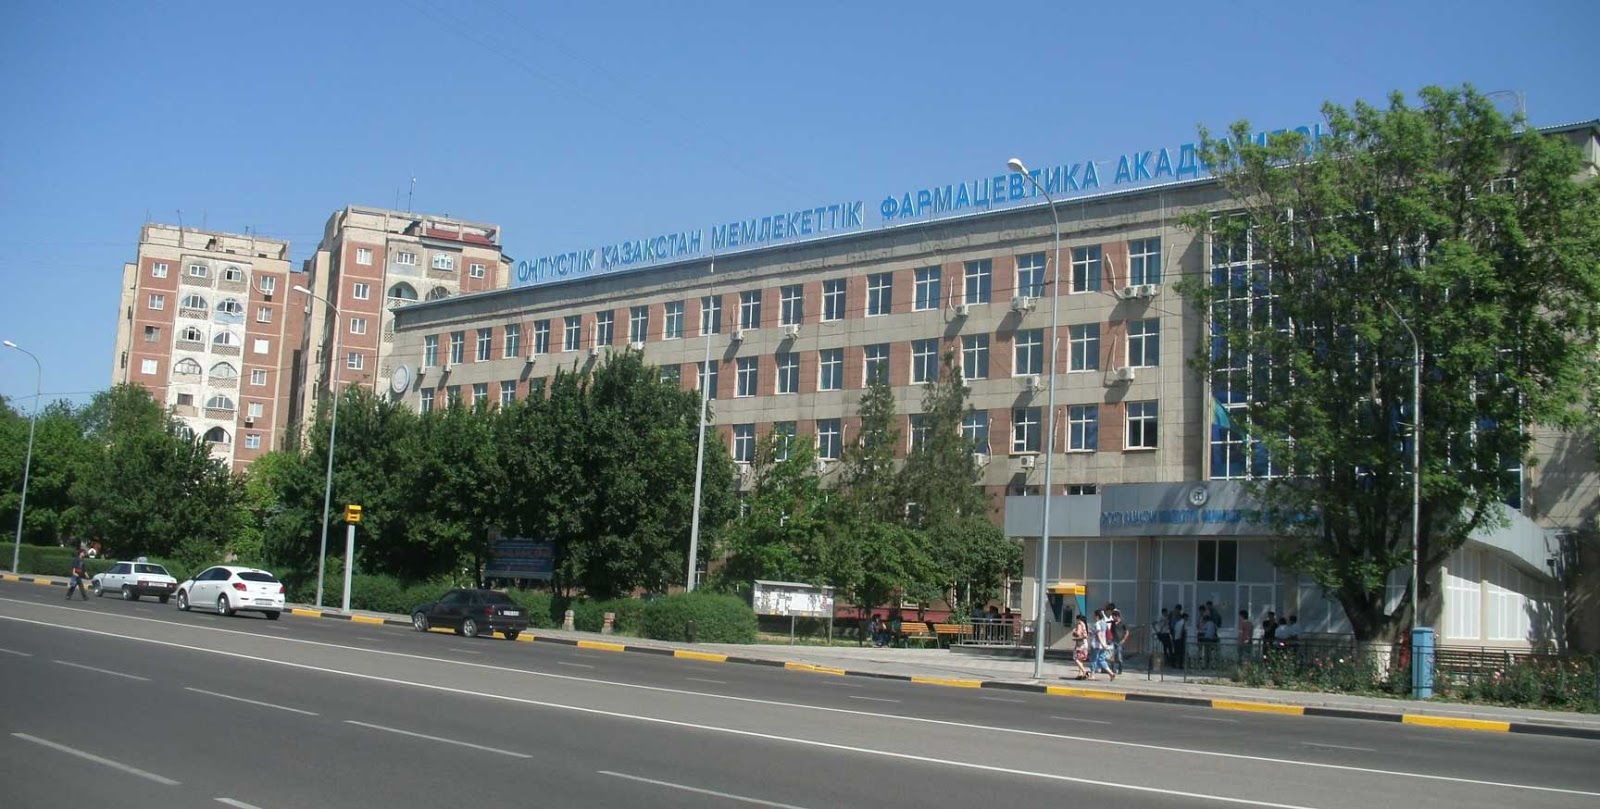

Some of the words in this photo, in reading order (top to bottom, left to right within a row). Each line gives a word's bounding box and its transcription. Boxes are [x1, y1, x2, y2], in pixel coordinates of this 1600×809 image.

[601, 228, 703, 271] ҚАЗАҚСТАН
[712, 200, 864, 249] МЕМЛЕКЕТТІК
[880, 160, 1100, 220] ФАРМАЦЕВТИКА
